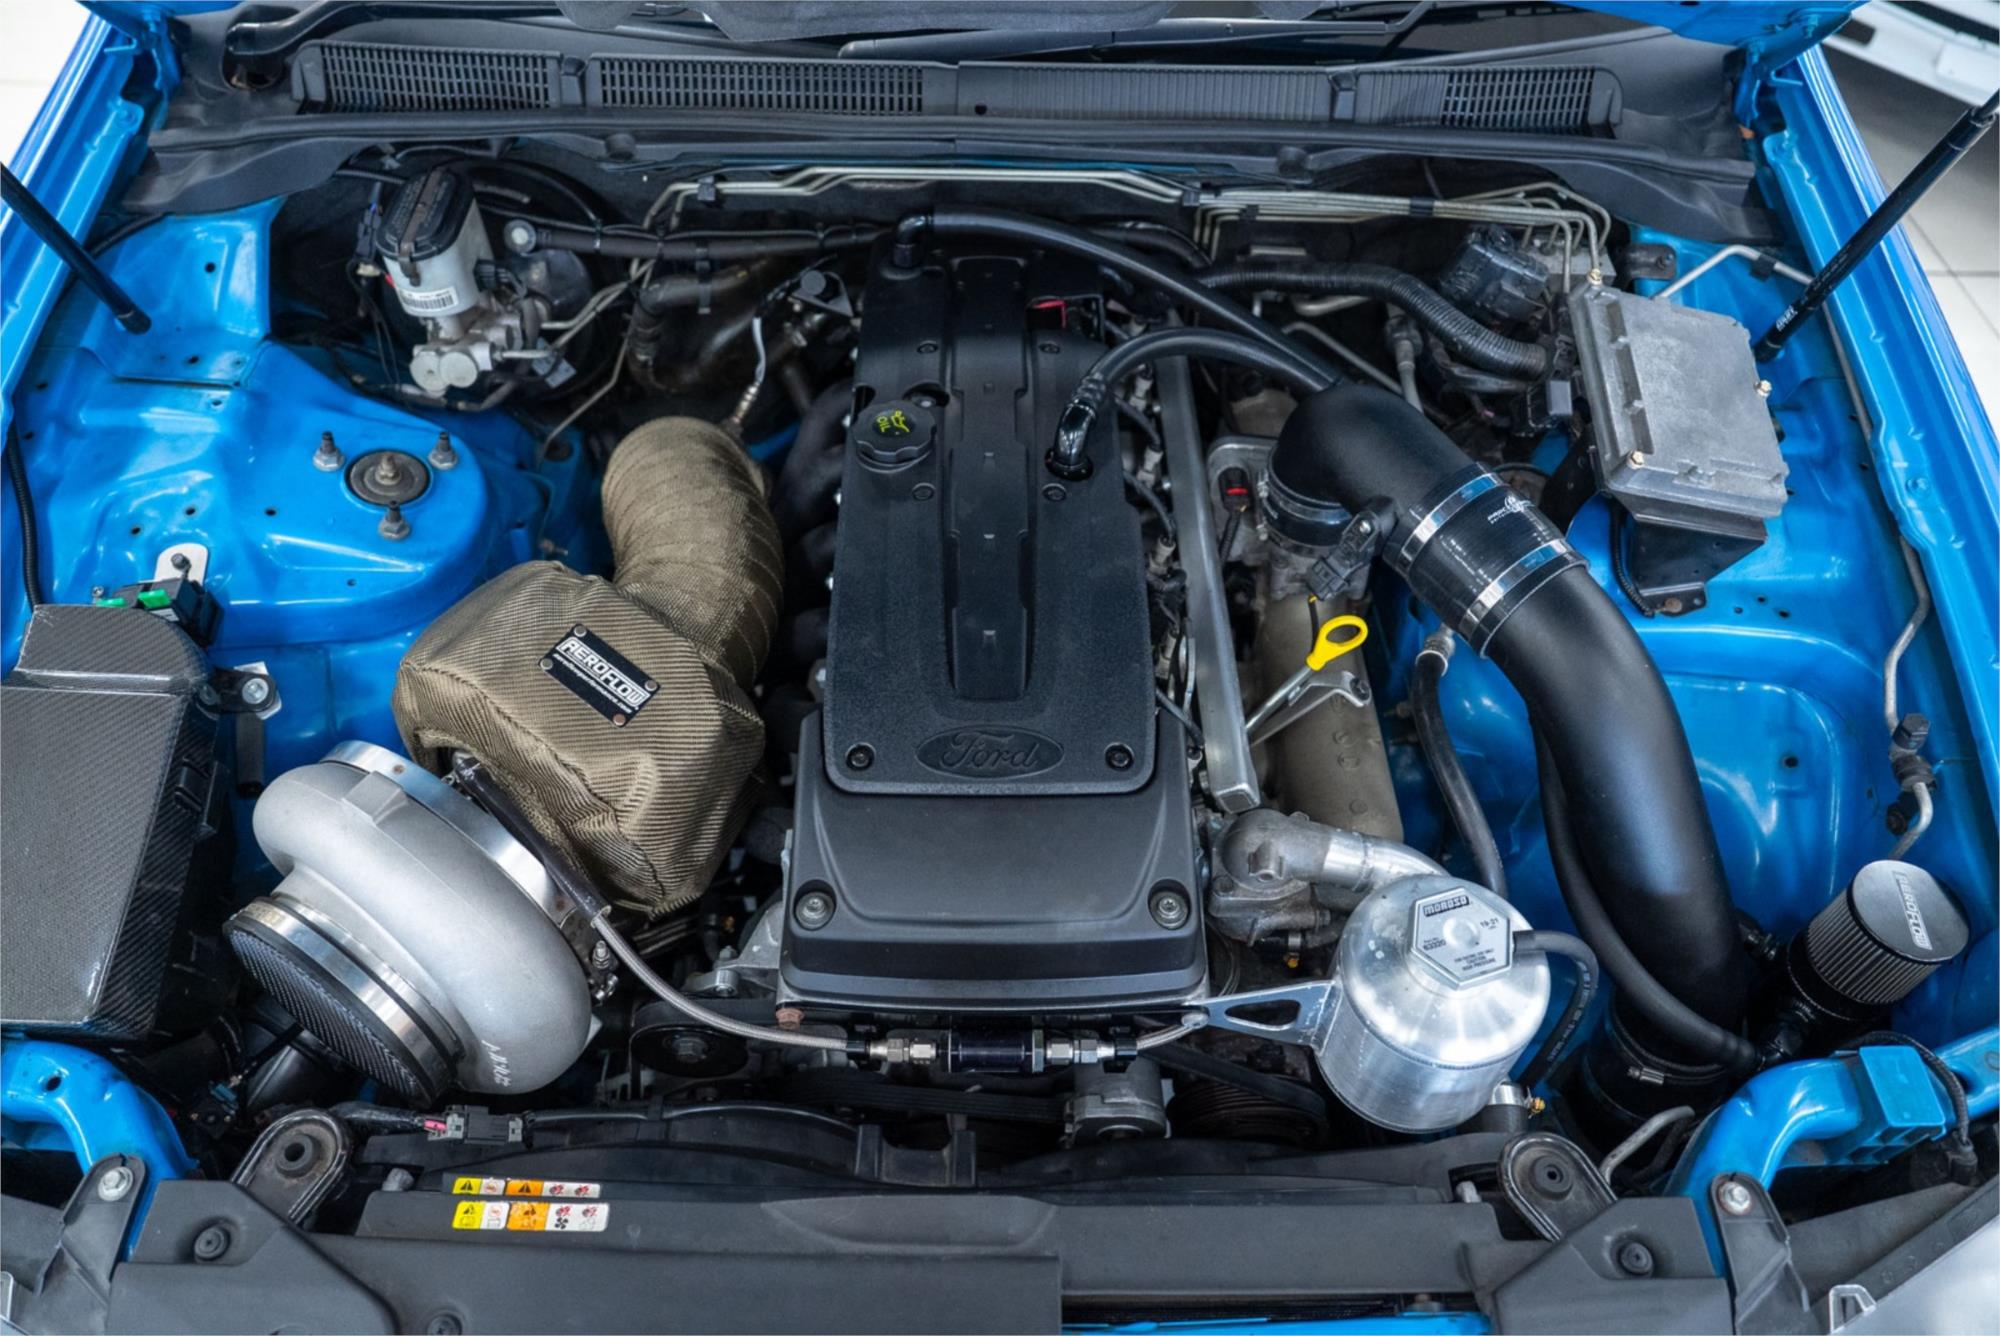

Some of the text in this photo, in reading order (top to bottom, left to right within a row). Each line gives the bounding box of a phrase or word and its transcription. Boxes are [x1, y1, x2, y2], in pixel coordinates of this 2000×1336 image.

[876, 416, 891, 433] OIL
[558, 639, 647, 705] AEROFLOW
[939, 730, 1040, 769] Ford
[1423, 895, 1469, 916] MOROSO
[1897, 873, 1931, 948] AEROFLOW
